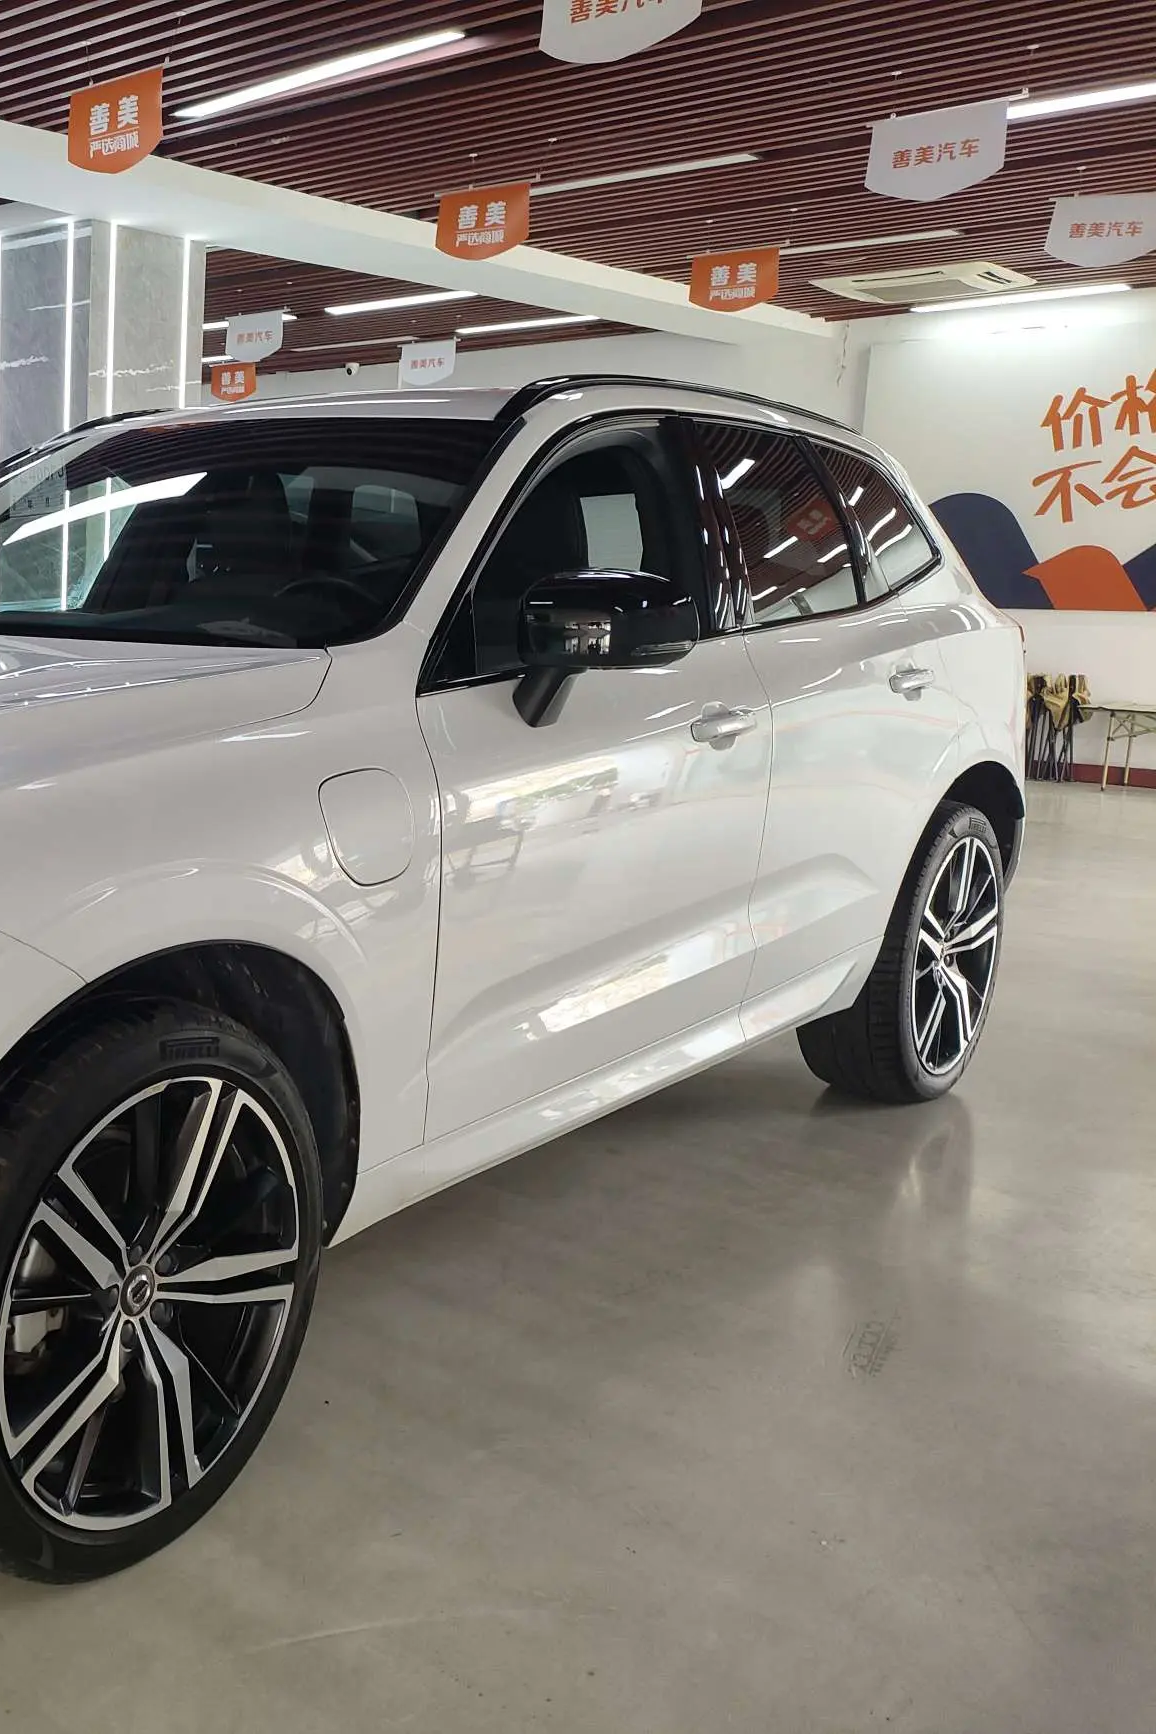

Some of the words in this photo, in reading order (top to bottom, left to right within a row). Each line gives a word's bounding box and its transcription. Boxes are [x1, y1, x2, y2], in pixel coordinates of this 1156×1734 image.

[89, 94, 139, 135] 善美
[88, 131, 140, 159] 严选商城
[891, 138, 980, 170] 善美汽车
[457, 200, 507, 229] 善美
[1068, 220, 1144, 239] 善美汽车
[710, 261, 759, 287] 善美
[236, 329, 274, 346] 善美汽车
[410, 357, 446, 370] 善美汽车
[1032, 446, 1156, 524] 不会
